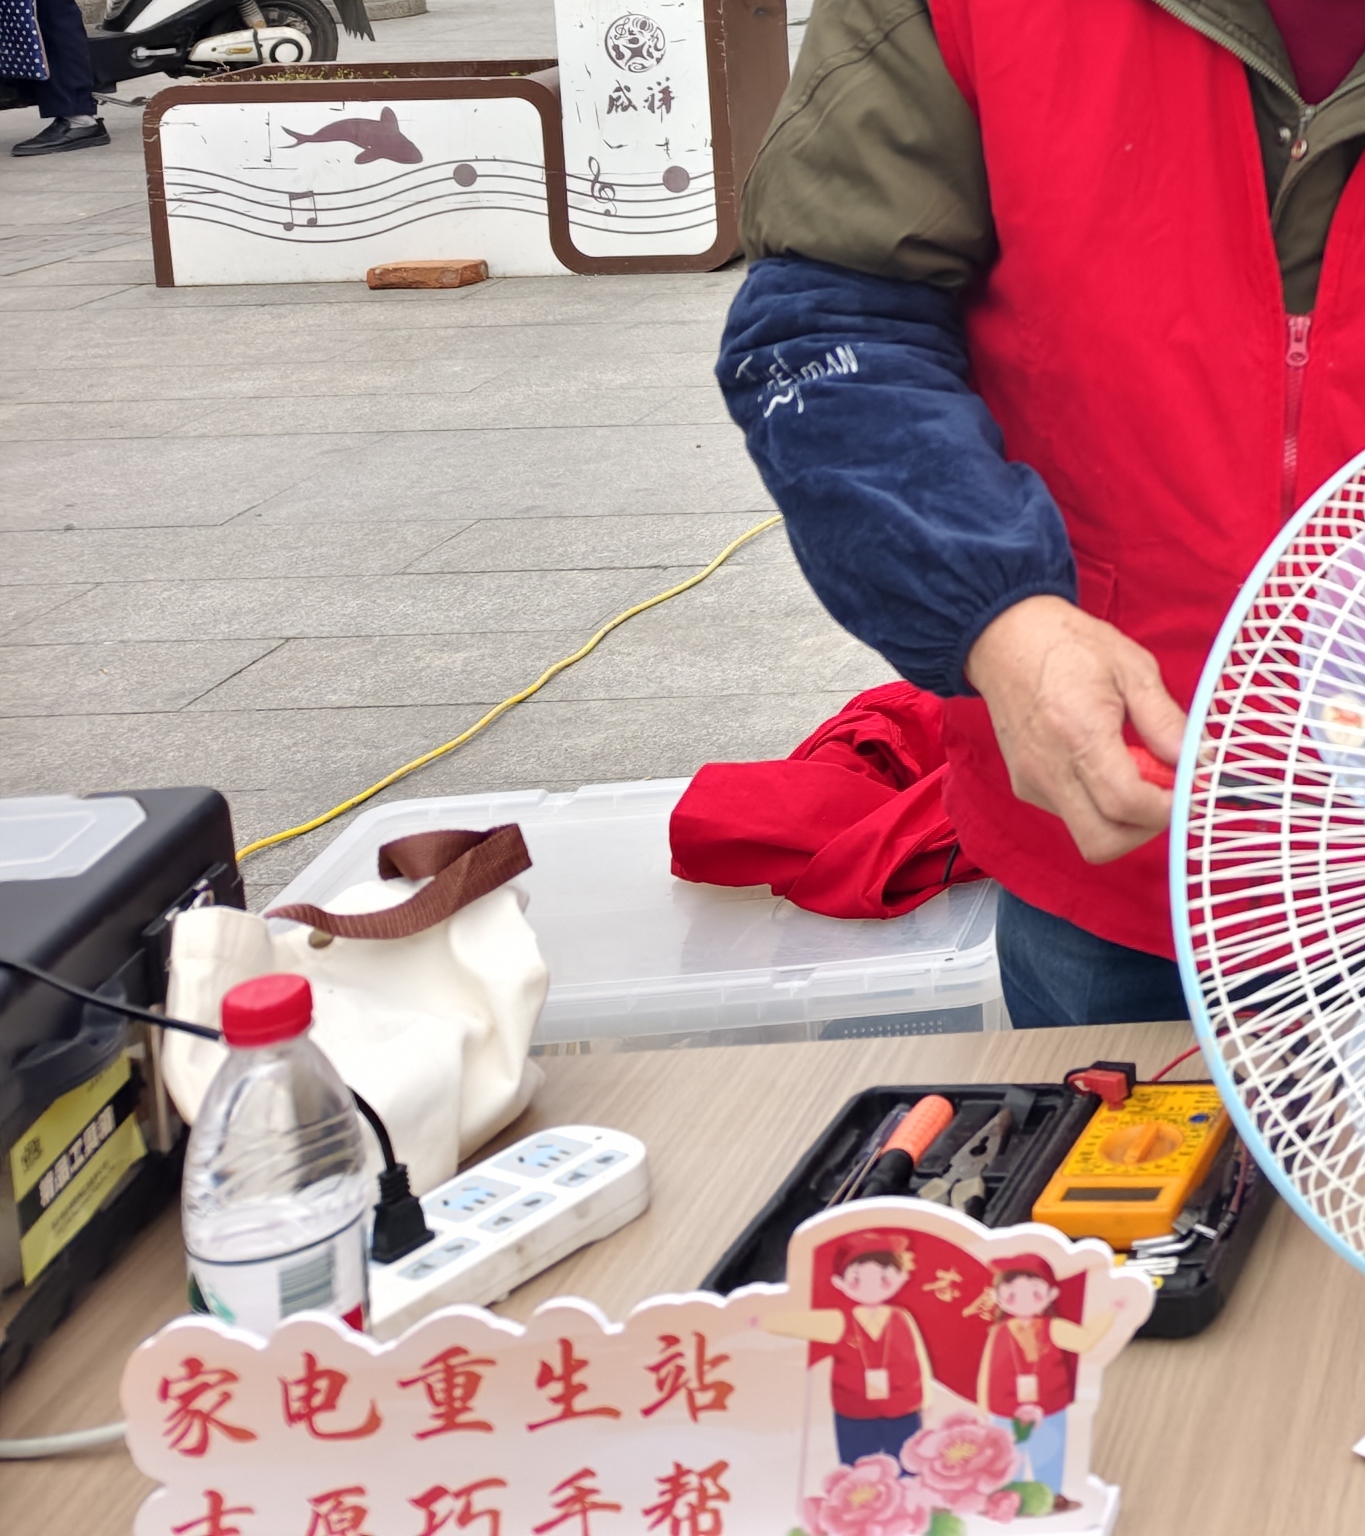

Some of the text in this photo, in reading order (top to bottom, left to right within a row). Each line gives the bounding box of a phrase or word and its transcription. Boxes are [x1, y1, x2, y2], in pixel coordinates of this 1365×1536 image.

[155, 1331, 738, 1459] 家电重生站
